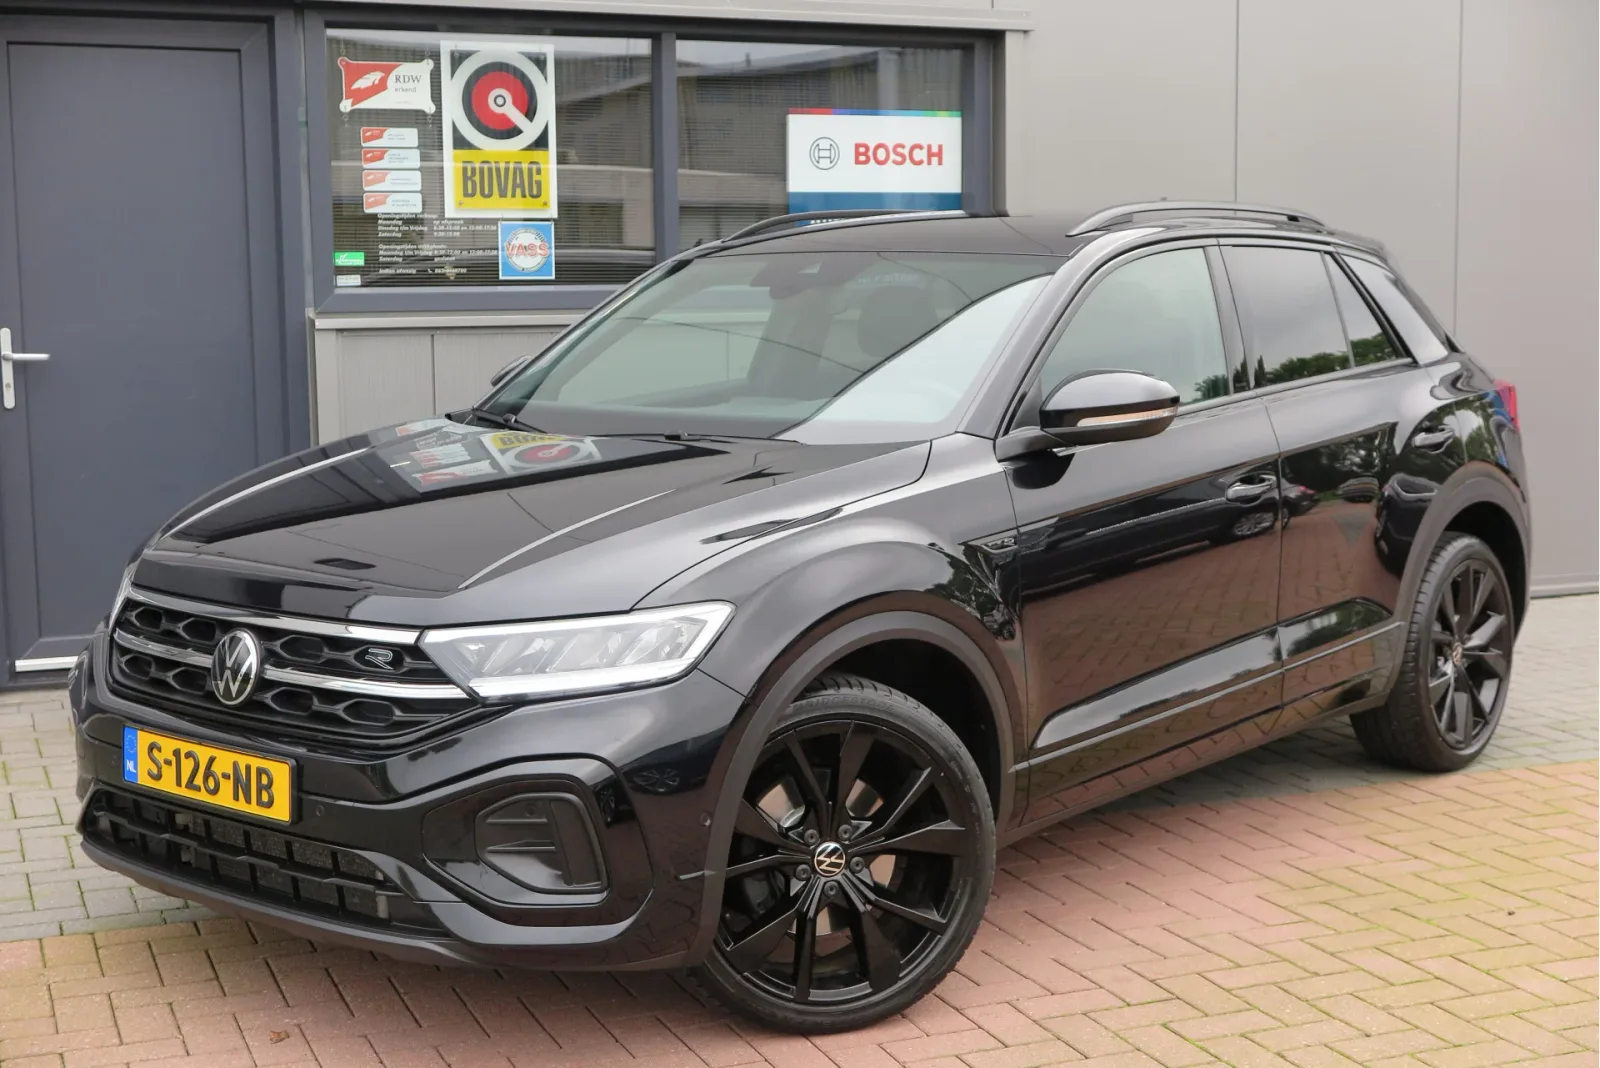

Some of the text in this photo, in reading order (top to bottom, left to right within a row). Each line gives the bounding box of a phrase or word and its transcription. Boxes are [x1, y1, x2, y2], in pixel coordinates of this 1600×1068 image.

[394, 75, 422, 84] RDW
[854, 142, 943, 166] BOSCH
[461, 160, 542, 199] BOVAG
[504, 242, 550, 258] VASS
[365, 647, 393, 670] R
[126, 759, 137, 773] NL
[147, 741, 275, 809] S-126-NB
